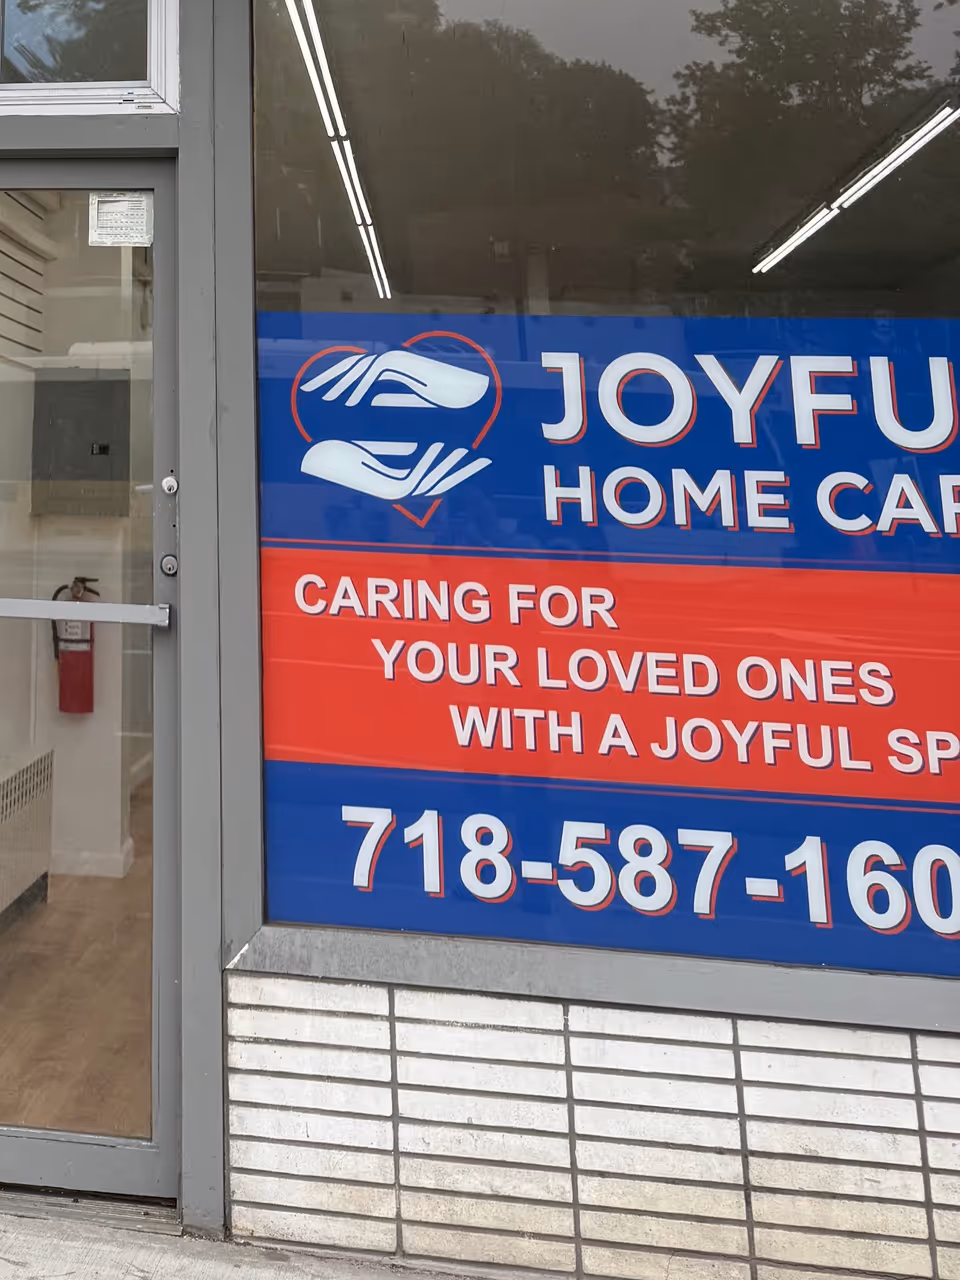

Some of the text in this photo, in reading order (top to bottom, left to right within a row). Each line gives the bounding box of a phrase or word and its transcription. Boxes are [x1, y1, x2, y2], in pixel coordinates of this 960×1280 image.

[541, 352, 959, 453] JOYFU
[543, 465, 794, 532] HOME
[294, 574, 619, 628] CARING FOR
[371, 638, 896, 706] YOUR LOVED ONES
[449, 704, 960, 776] WITH A JOYFUL SP
[341, 805, 960, 940] 718-587-160
